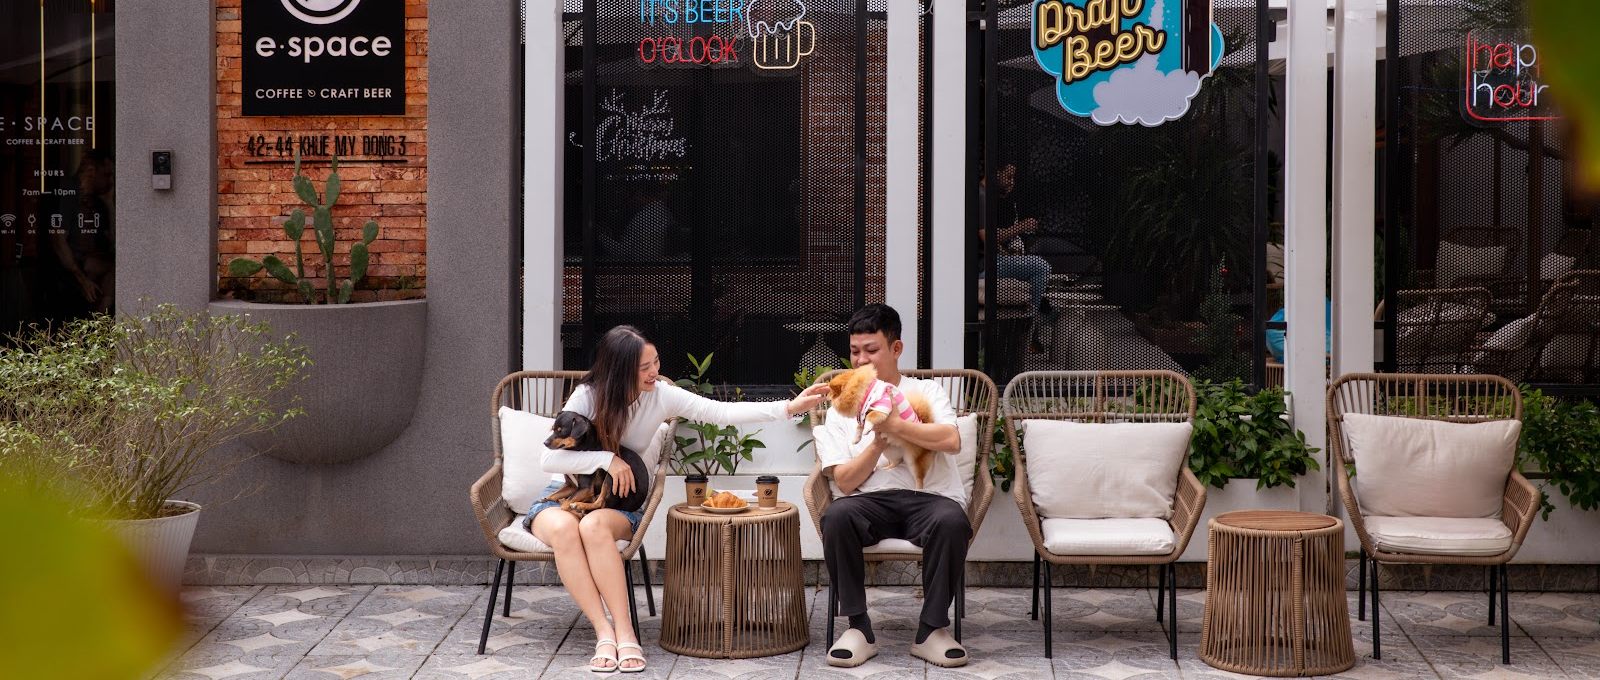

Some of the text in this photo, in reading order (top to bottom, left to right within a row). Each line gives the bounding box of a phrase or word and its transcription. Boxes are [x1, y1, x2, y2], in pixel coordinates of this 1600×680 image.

[640, 0, 744, 26] IT'S BEER
[1064, 24, 1165, 83] Beer
[255, 88, 392, 99] COFFEE CRAFT BEER
[1472, 71, 1549, 108] hour
[300, 135, 330, 156] KHUE
[335, 135, 356, 156] MY
[363, 135, 395, 156] DONG
[398, 135, 407, 156] 3
[33, 169, 65, 177] HOURS
[22, 188, 40, 196] 7am
[53, 188, 76, 197] 10pm
